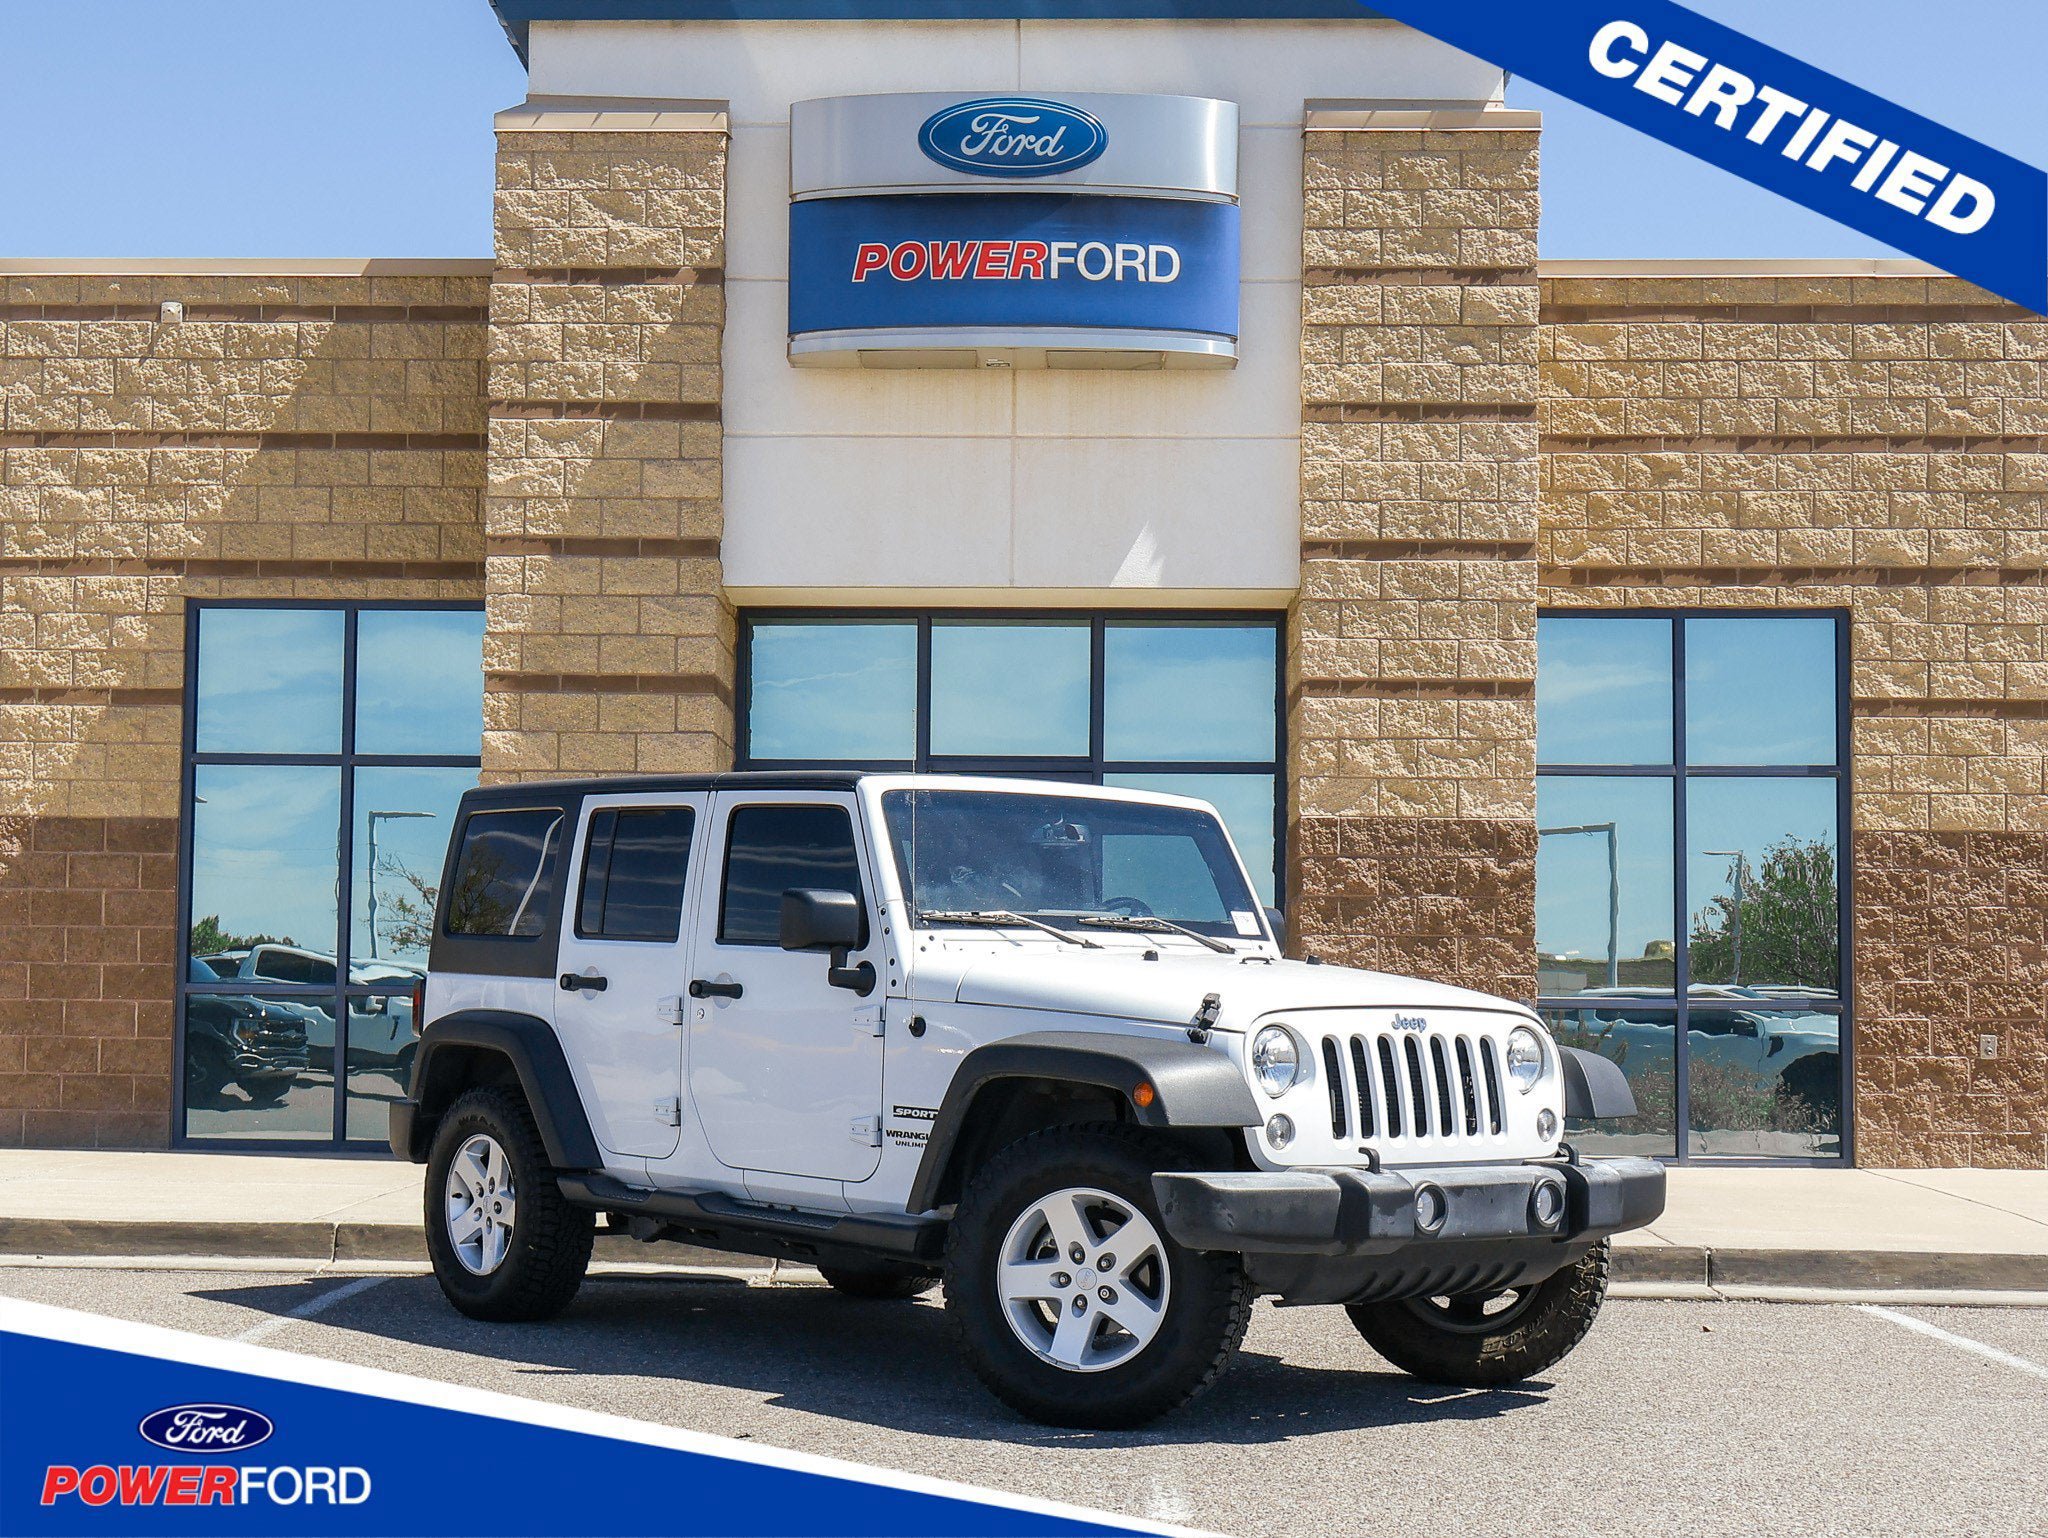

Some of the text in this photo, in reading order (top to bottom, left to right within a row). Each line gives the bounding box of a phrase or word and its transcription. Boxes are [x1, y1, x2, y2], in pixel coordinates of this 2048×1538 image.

[960, 113, 1067, 157] Ford
[1391, 1013, 1427, 1033] Jeep
[895, 1108, 939, 1118] SPORT
